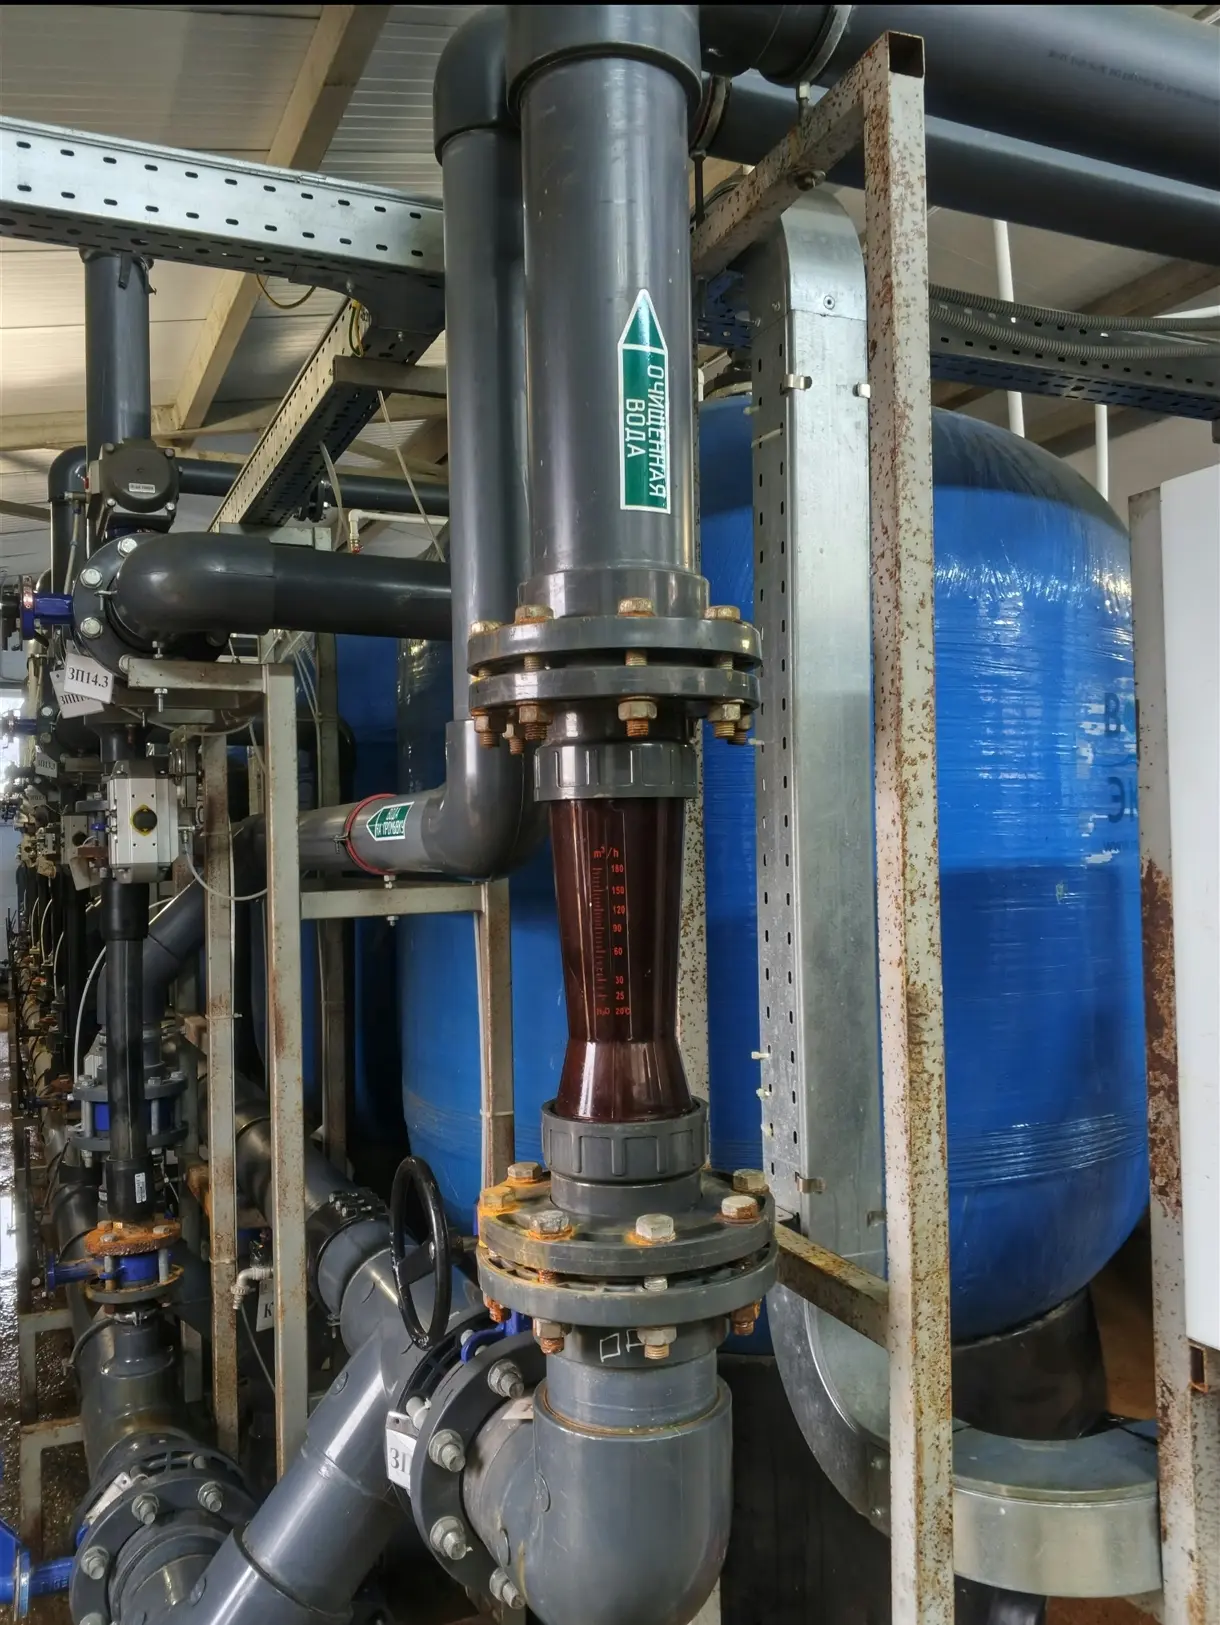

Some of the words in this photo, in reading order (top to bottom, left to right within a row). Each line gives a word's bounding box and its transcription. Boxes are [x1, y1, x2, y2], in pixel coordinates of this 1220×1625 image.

[625, 398, 646, 458] ВОДА
[646, 365, 666, 498] ОЧИЩЕННАЯ
[68, 667, 109, 688] ЗП14.3
[612, 886, 625, 895] 150
[613, 905, 626, 915] 120
[613, 923, 622, 933] 90
[615, 975, 624, 985] 30
[615, 991, 625, 1000] 25
